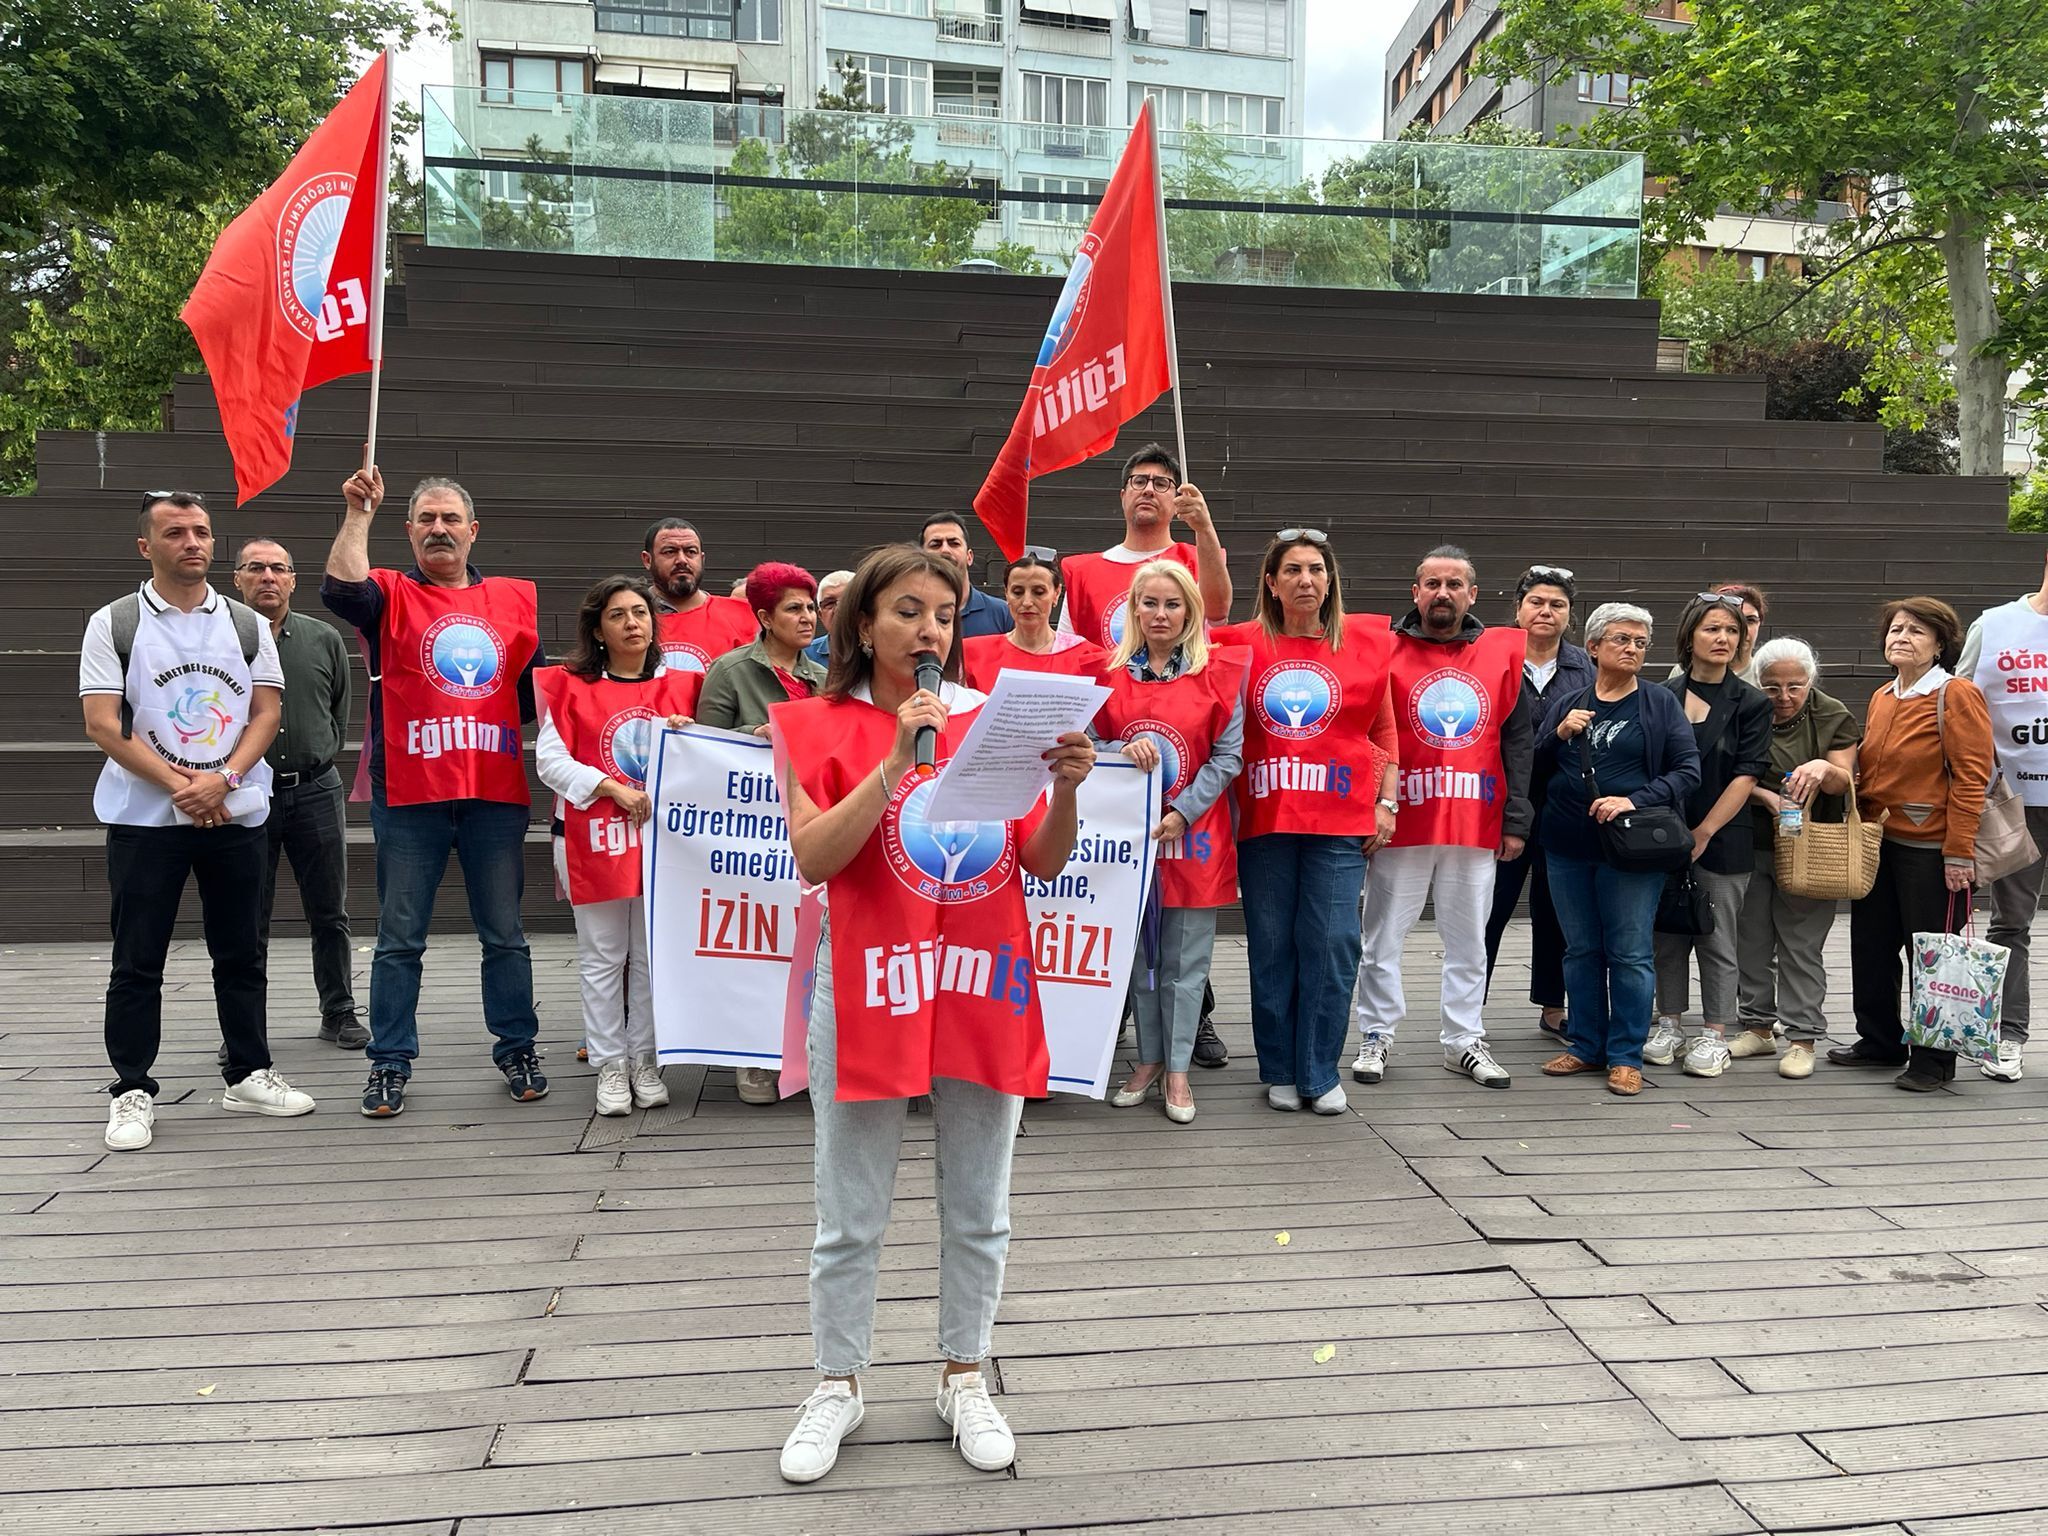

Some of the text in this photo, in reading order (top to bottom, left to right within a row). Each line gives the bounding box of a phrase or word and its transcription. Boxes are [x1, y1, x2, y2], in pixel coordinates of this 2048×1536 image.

[428, 621, 447, 638] BİLİM
[425, 639, 432, 650] VE
[201, 664, 245, 696] SENDİKASI
[893, 774, 921, 802] BİLİM
[886, 803, 898, 820] VE
[886, 826, 911, 874] EĞİTİM
[699, 888, 779, 953] İZİN
[1028, 911, 1113, 979] ĞİZ!
[1929, 981, 1979, 999] eczane
